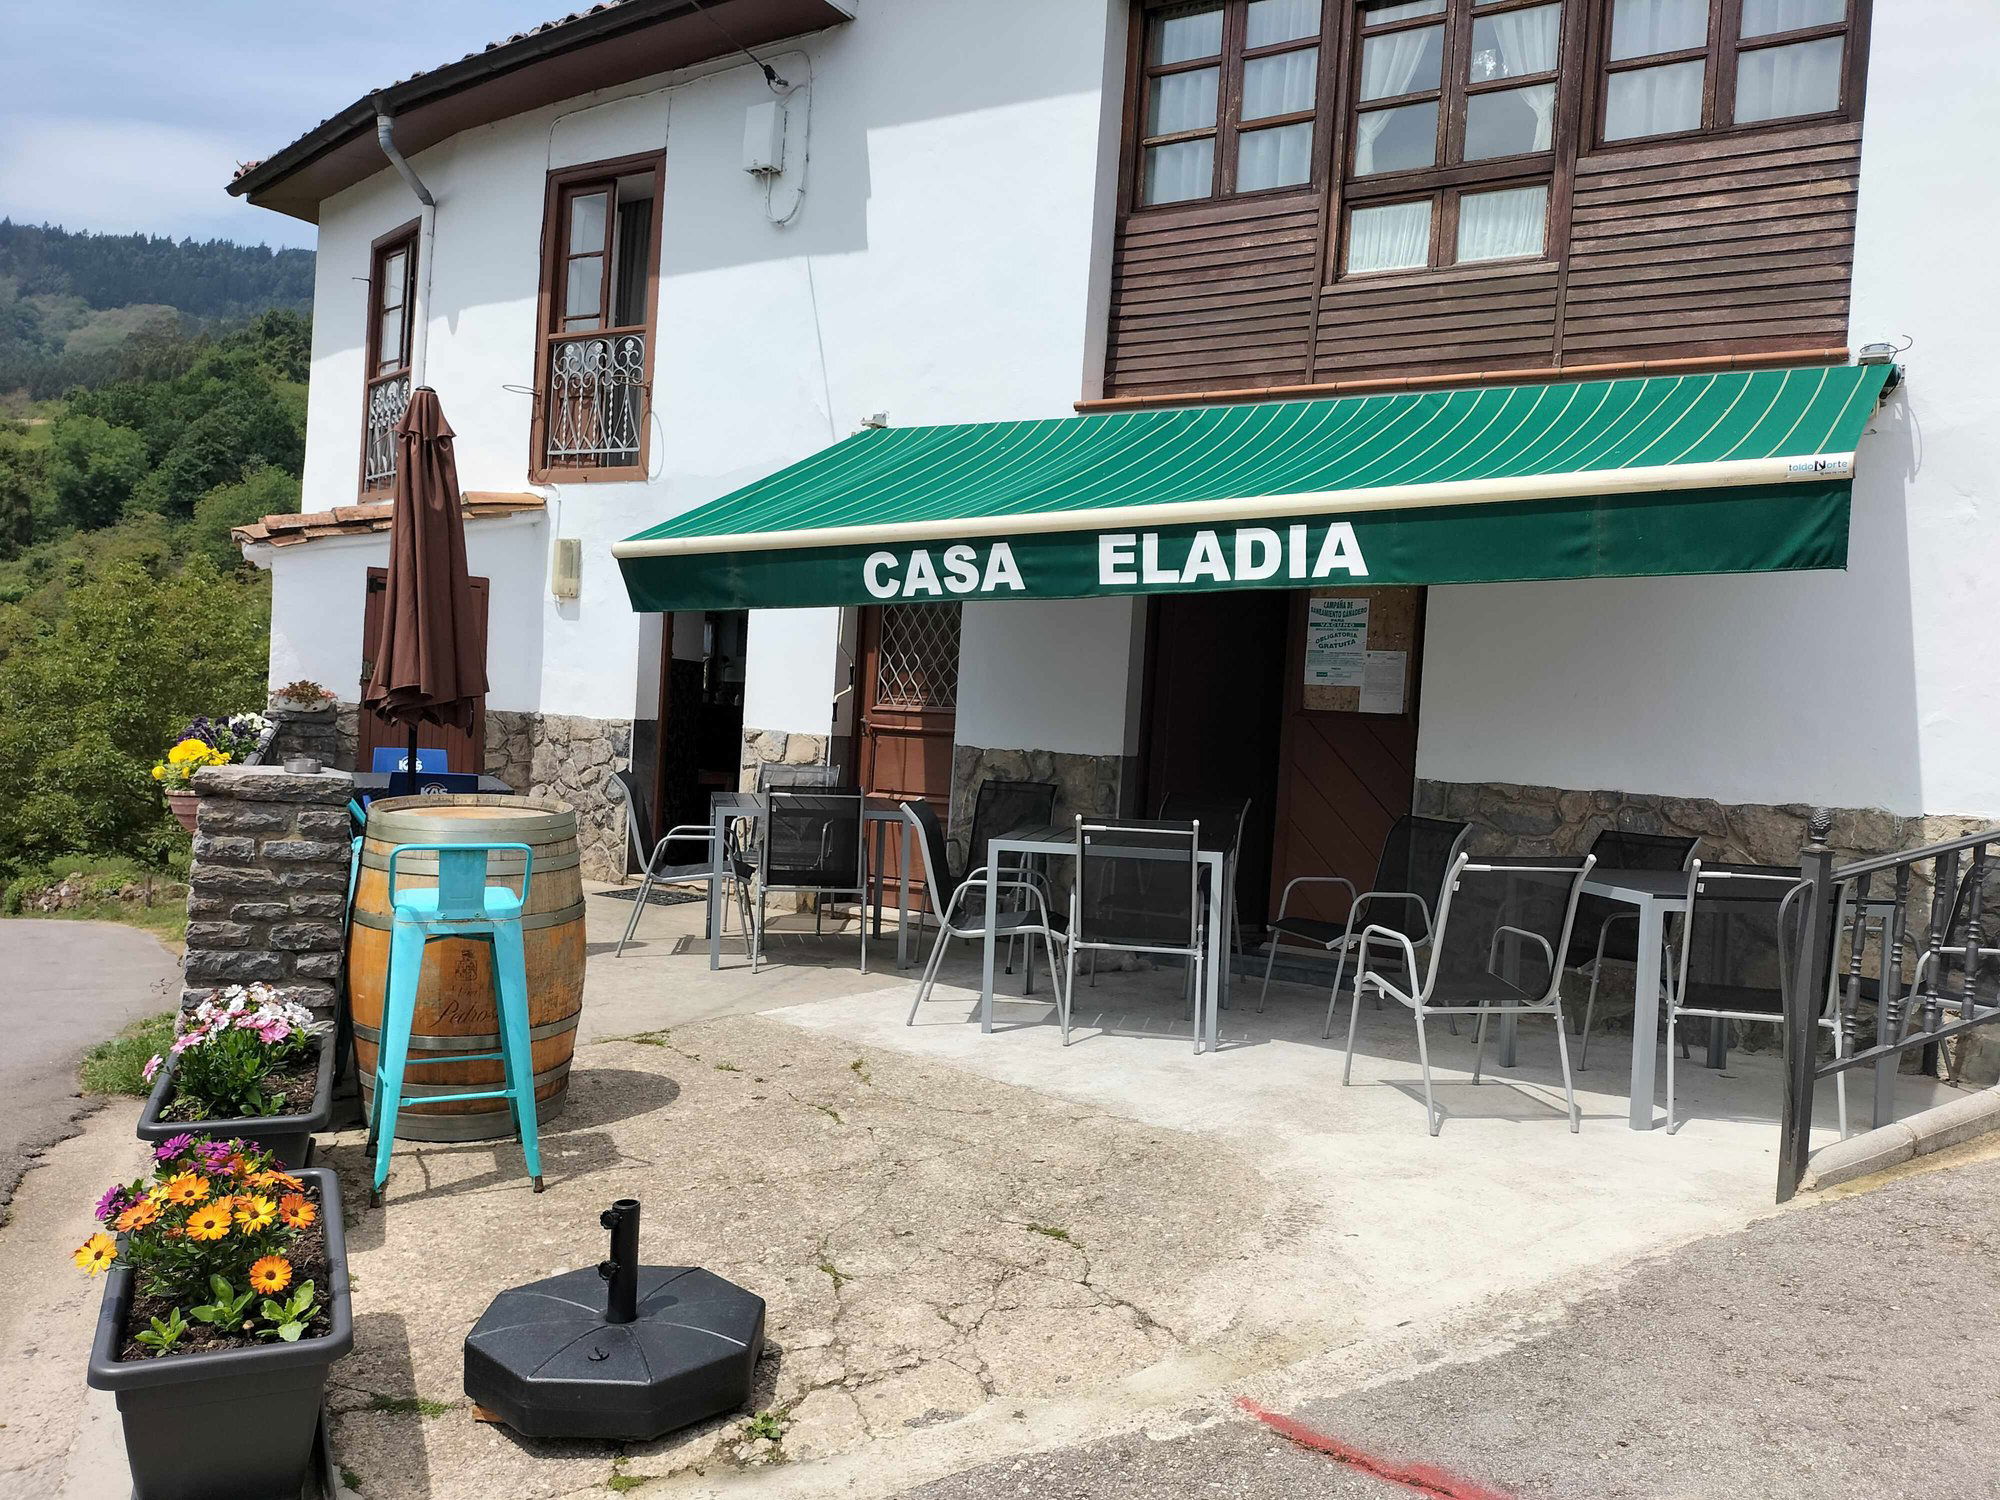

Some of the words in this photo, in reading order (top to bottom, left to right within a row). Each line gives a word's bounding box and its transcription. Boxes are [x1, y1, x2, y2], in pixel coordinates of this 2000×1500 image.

[863, 542, 1026, 598] CASA
[1099, 522, 1369, 585] ELADIA
[1347, 601, 1354, 609] DE
[1315, 632, 1358, 644] OBLIGATORIA
[1318, 639, 1356, 649] GRATUITA
[398, 760, 423, 771] KS
